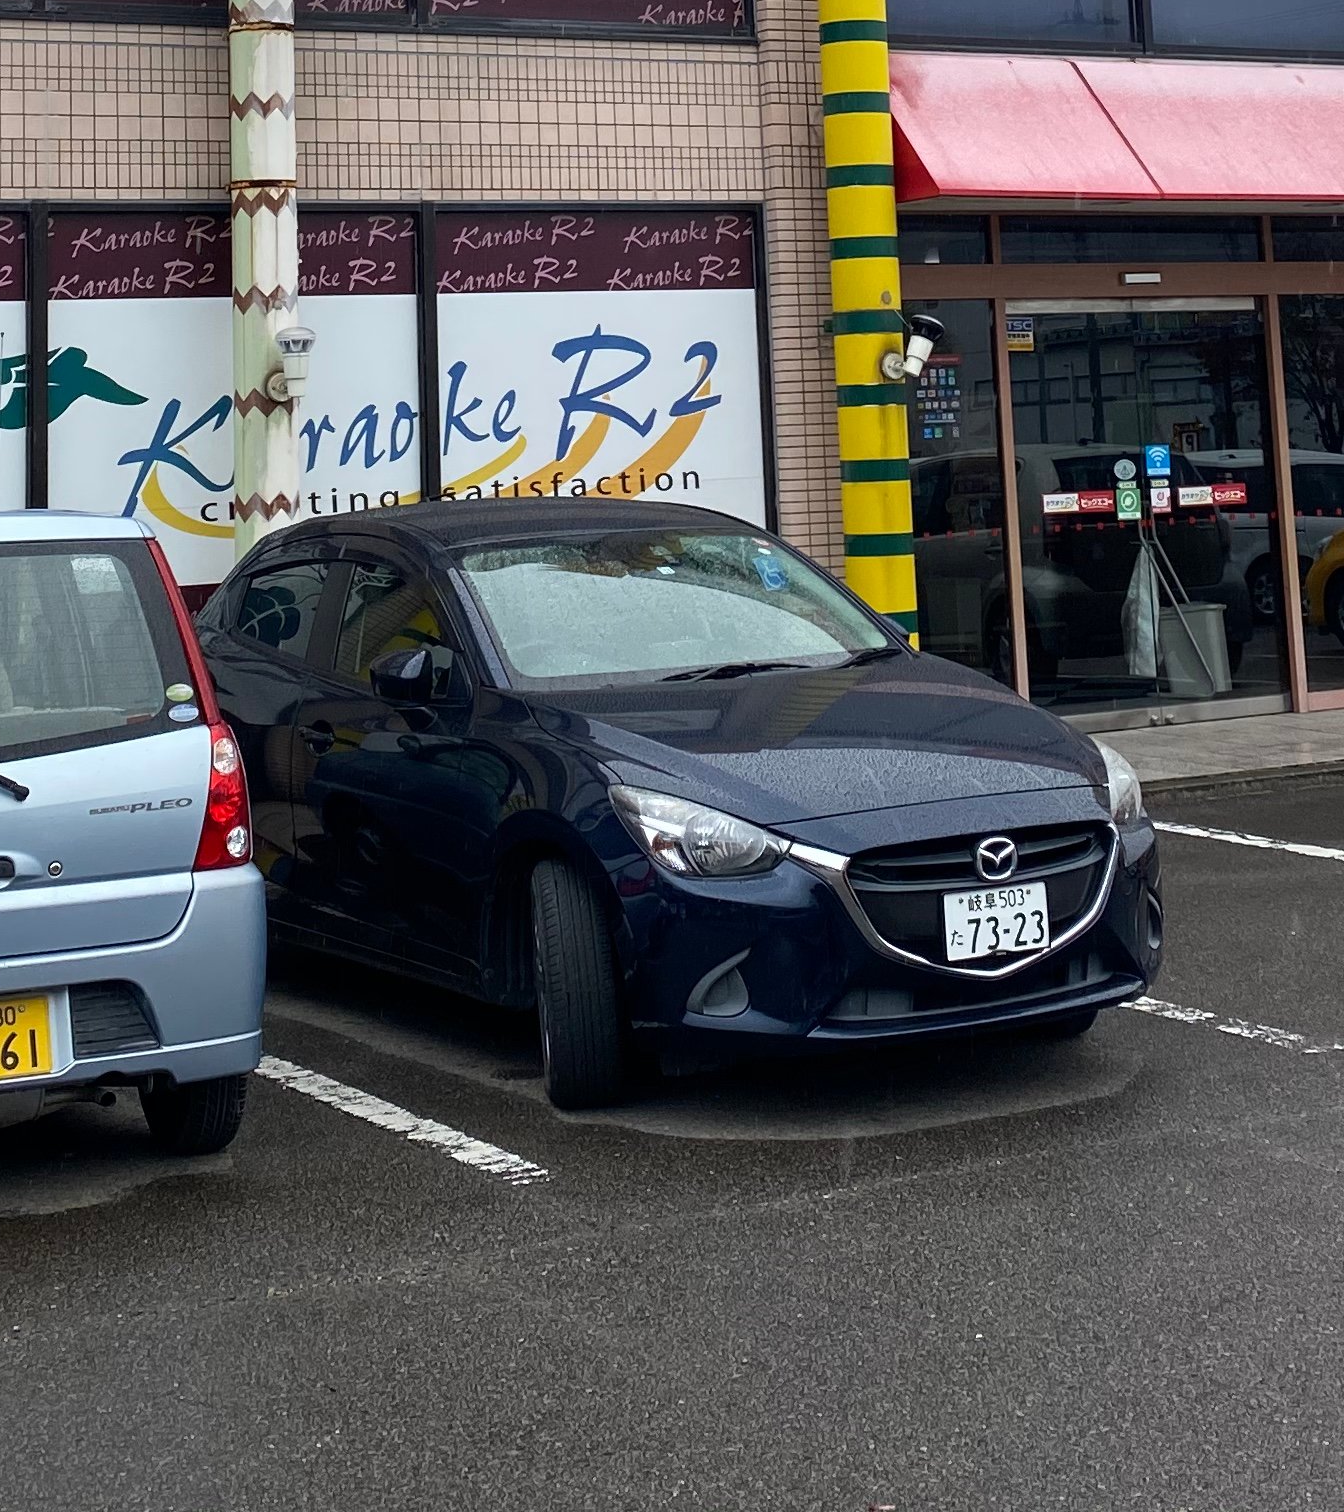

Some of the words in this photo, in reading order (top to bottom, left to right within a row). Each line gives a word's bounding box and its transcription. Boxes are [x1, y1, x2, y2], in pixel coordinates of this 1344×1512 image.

[638, 0, 726, 25] Karaoke
[71, 222, 176, 258] Karaoke
[368, 215, 415, 248] R2
[453, 221, 544, 254] Karaoke
[551, 215, 595, 246] R2
[623, 219, 708, 253] Karaoke
[49, 267, 154, 300] Karaoke
[164, 258, 215, 294] R2
[348, 257, 397, 292] R2
[436, 264, 525, 294] Karaoke
[533, 255, 578, 289] R2
[606, 261, 692, 292] Karaoke
[698, 253, 741, 286] R2
[117, 361, 524, 517] Kraoke
[552, 324, 722, 462] R2
[130, 797, 193, 814] PLEO
[951, 929, 964, 946] た
[967, 909, 1045, 954] 73-23
